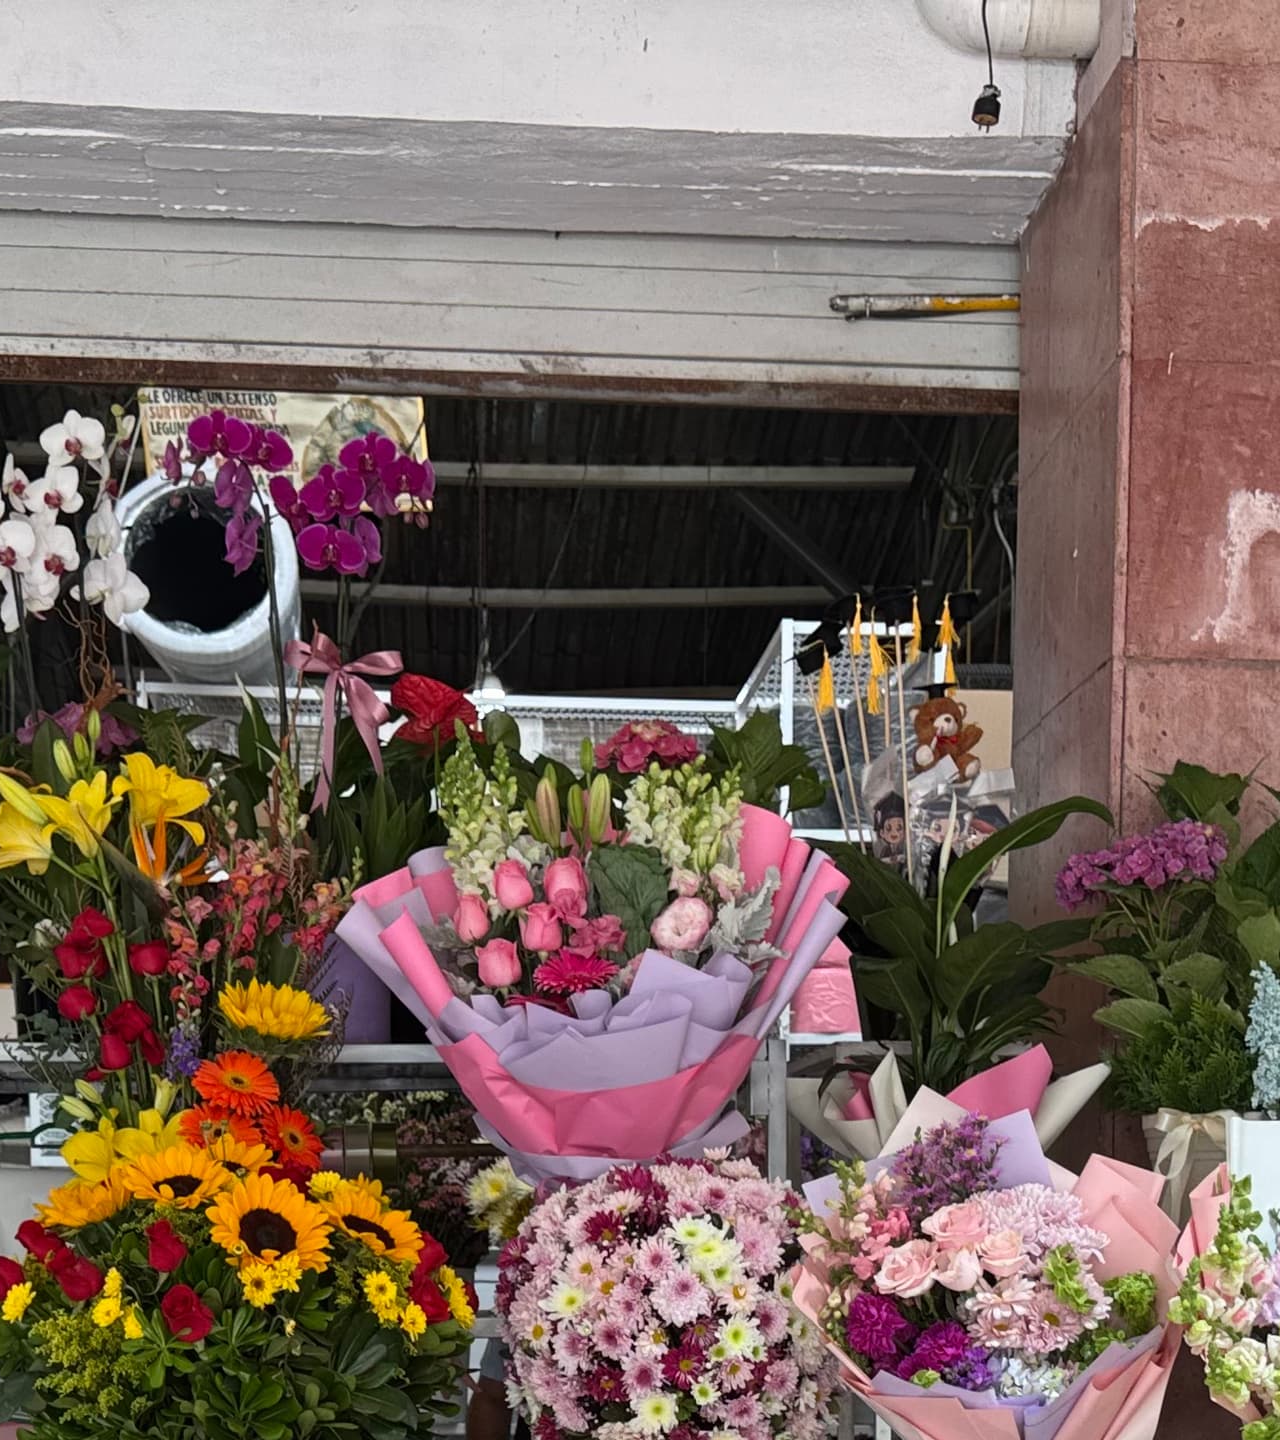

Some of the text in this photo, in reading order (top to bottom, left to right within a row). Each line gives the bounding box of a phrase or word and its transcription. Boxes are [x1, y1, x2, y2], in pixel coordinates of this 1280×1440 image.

[162, 389, 204, 404] OFRECE
[206, 391, 223, 404] UN
[226, 392, 277, 406] EXTENSO
[149, 404, 200, 420] SURTIDO
